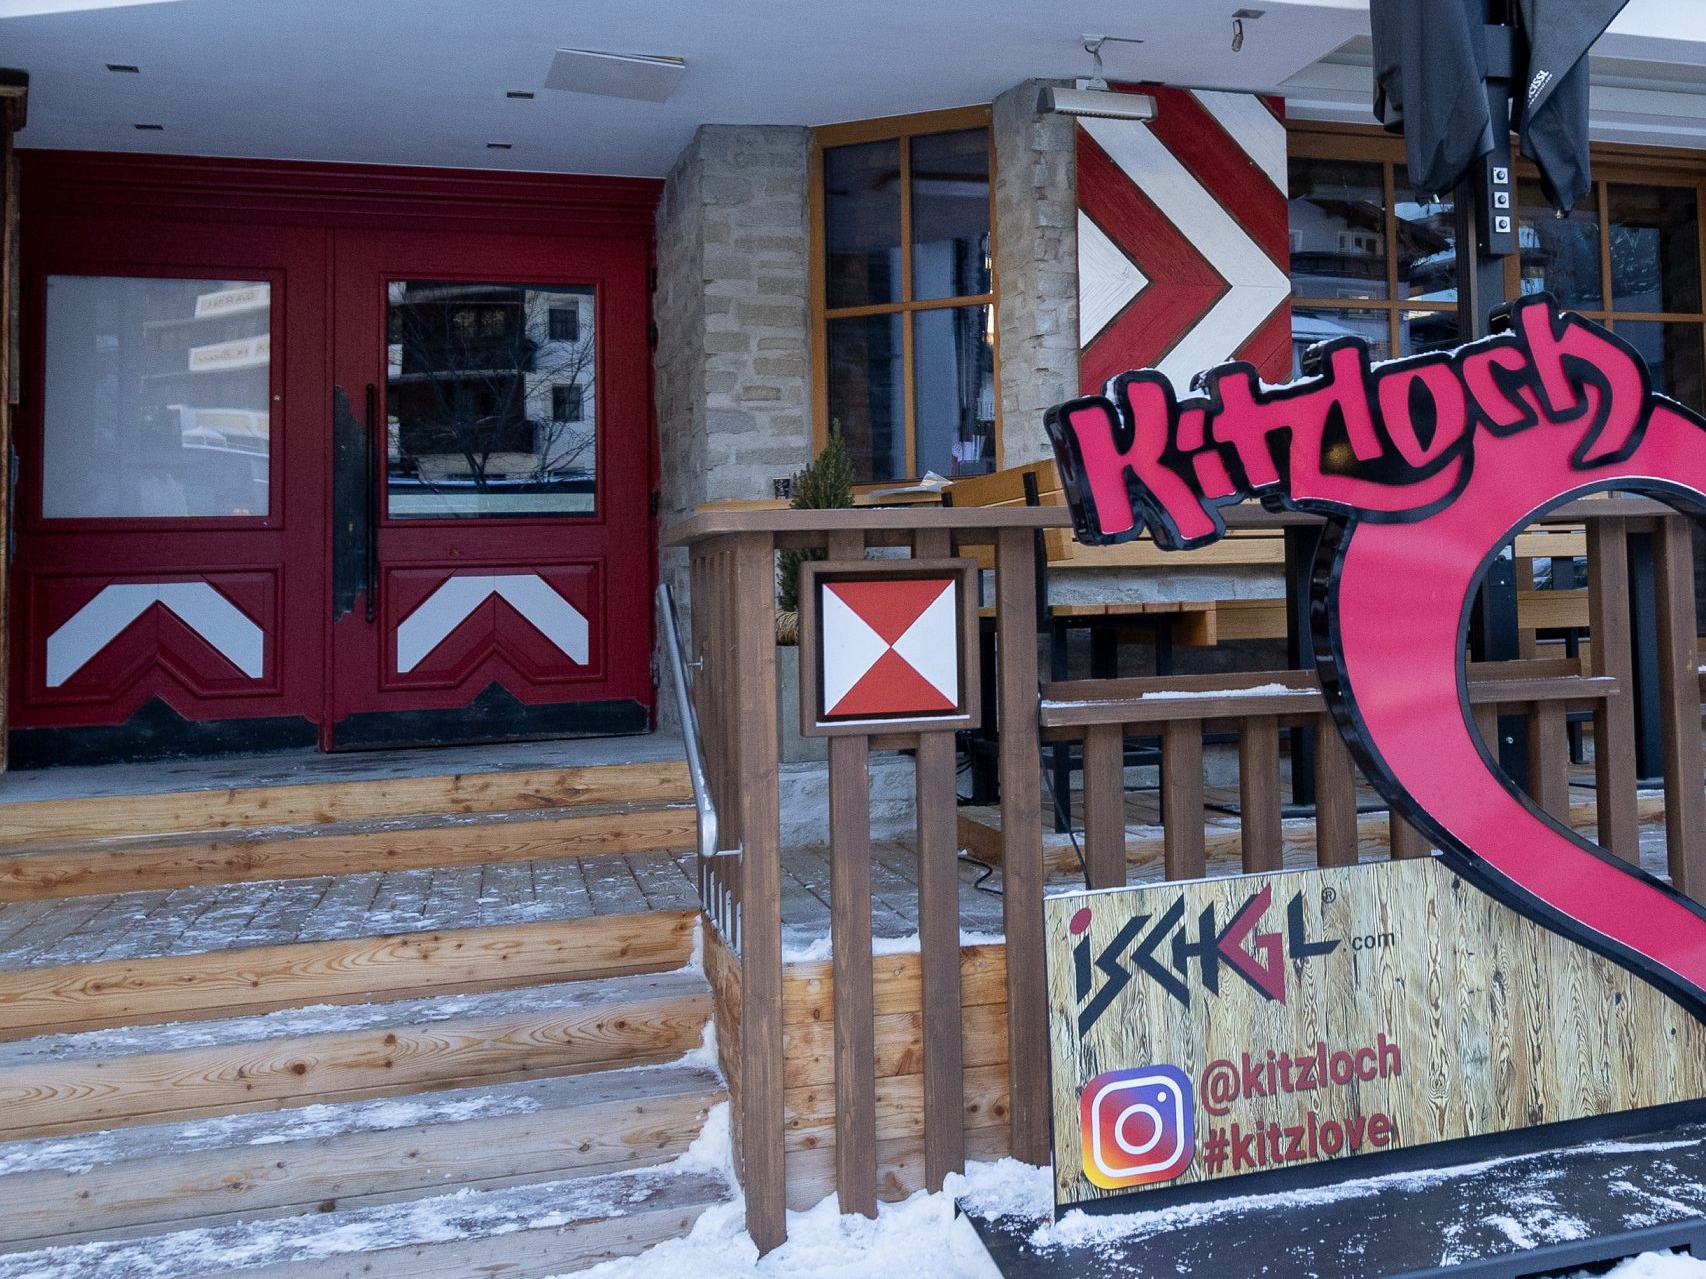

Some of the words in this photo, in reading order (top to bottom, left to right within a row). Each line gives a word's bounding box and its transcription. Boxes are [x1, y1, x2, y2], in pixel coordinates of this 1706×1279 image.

[1052, 295, 1648, 547] Kitzloch
[1200, 1032, 1402, 1116] @kitzloch
[1203, 1110, 1392, 1173] #kitzlove
